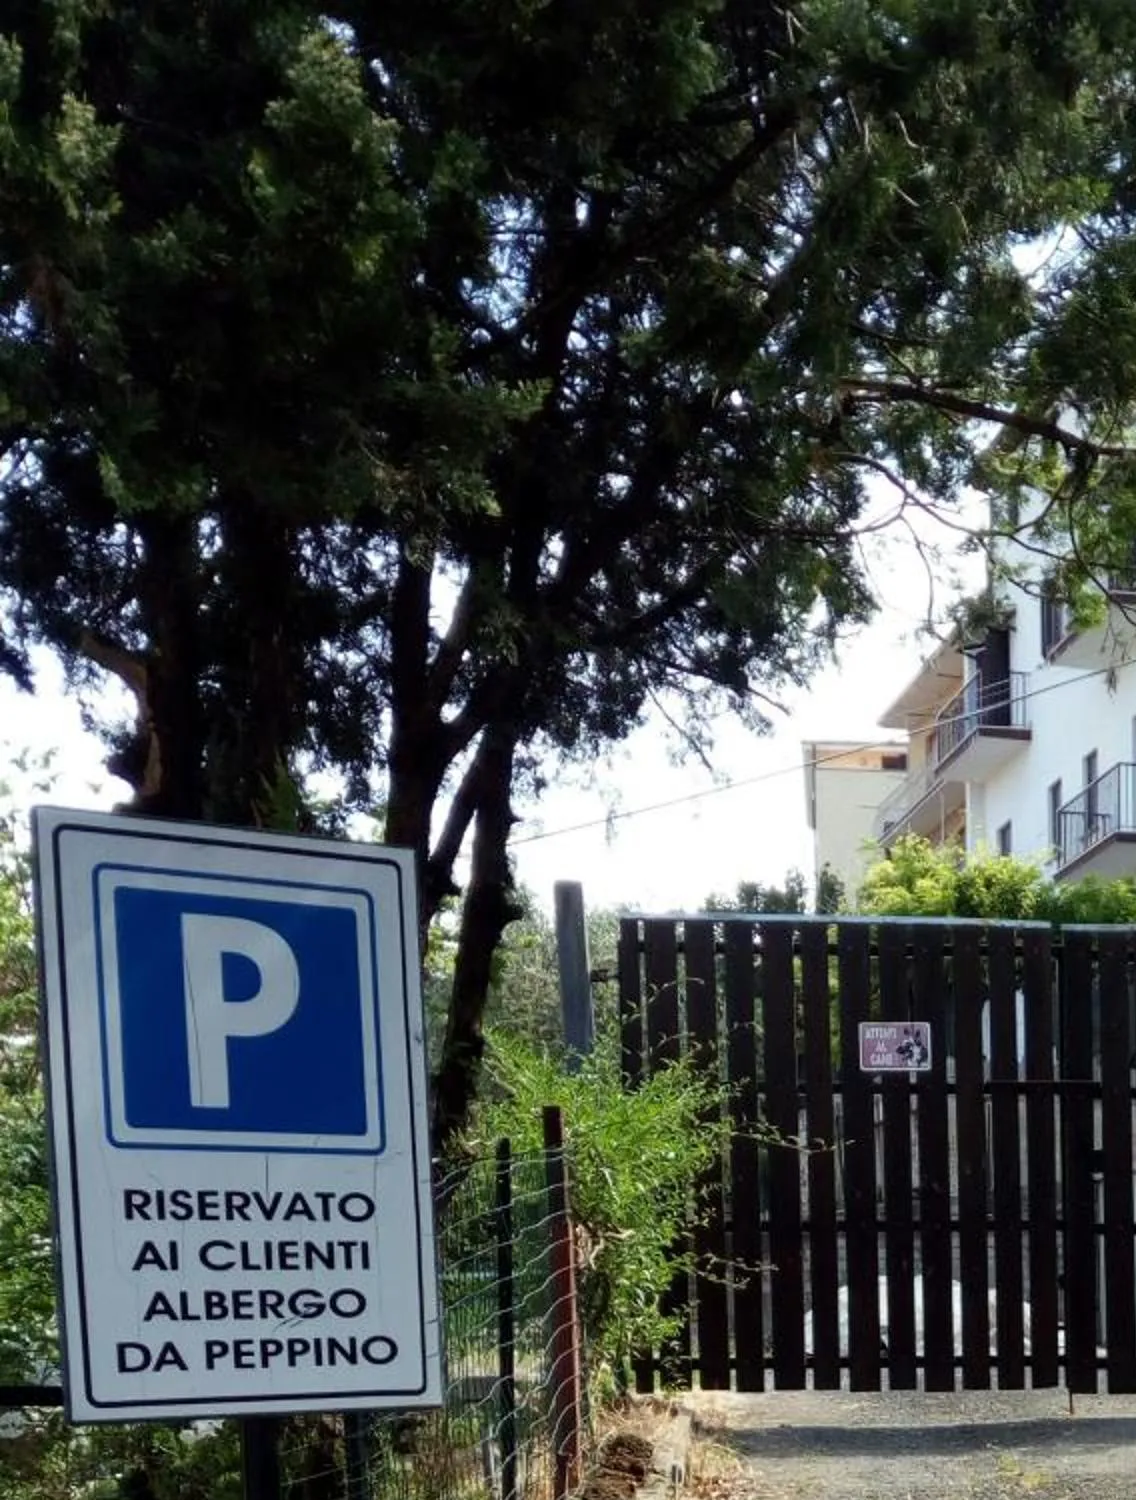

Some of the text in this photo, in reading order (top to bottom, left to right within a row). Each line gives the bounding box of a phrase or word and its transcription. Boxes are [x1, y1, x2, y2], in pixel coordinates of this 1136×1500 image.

[181, 912, 300, 1109] P
[123, 1189, 376, 1223] RISERVATO
[132, 1239, 370, 1271] AI CLIENTI
[143, 1288, 367, 1322] ALBERGO
[116, 1335, 399, 1373] DA PEPPINO
